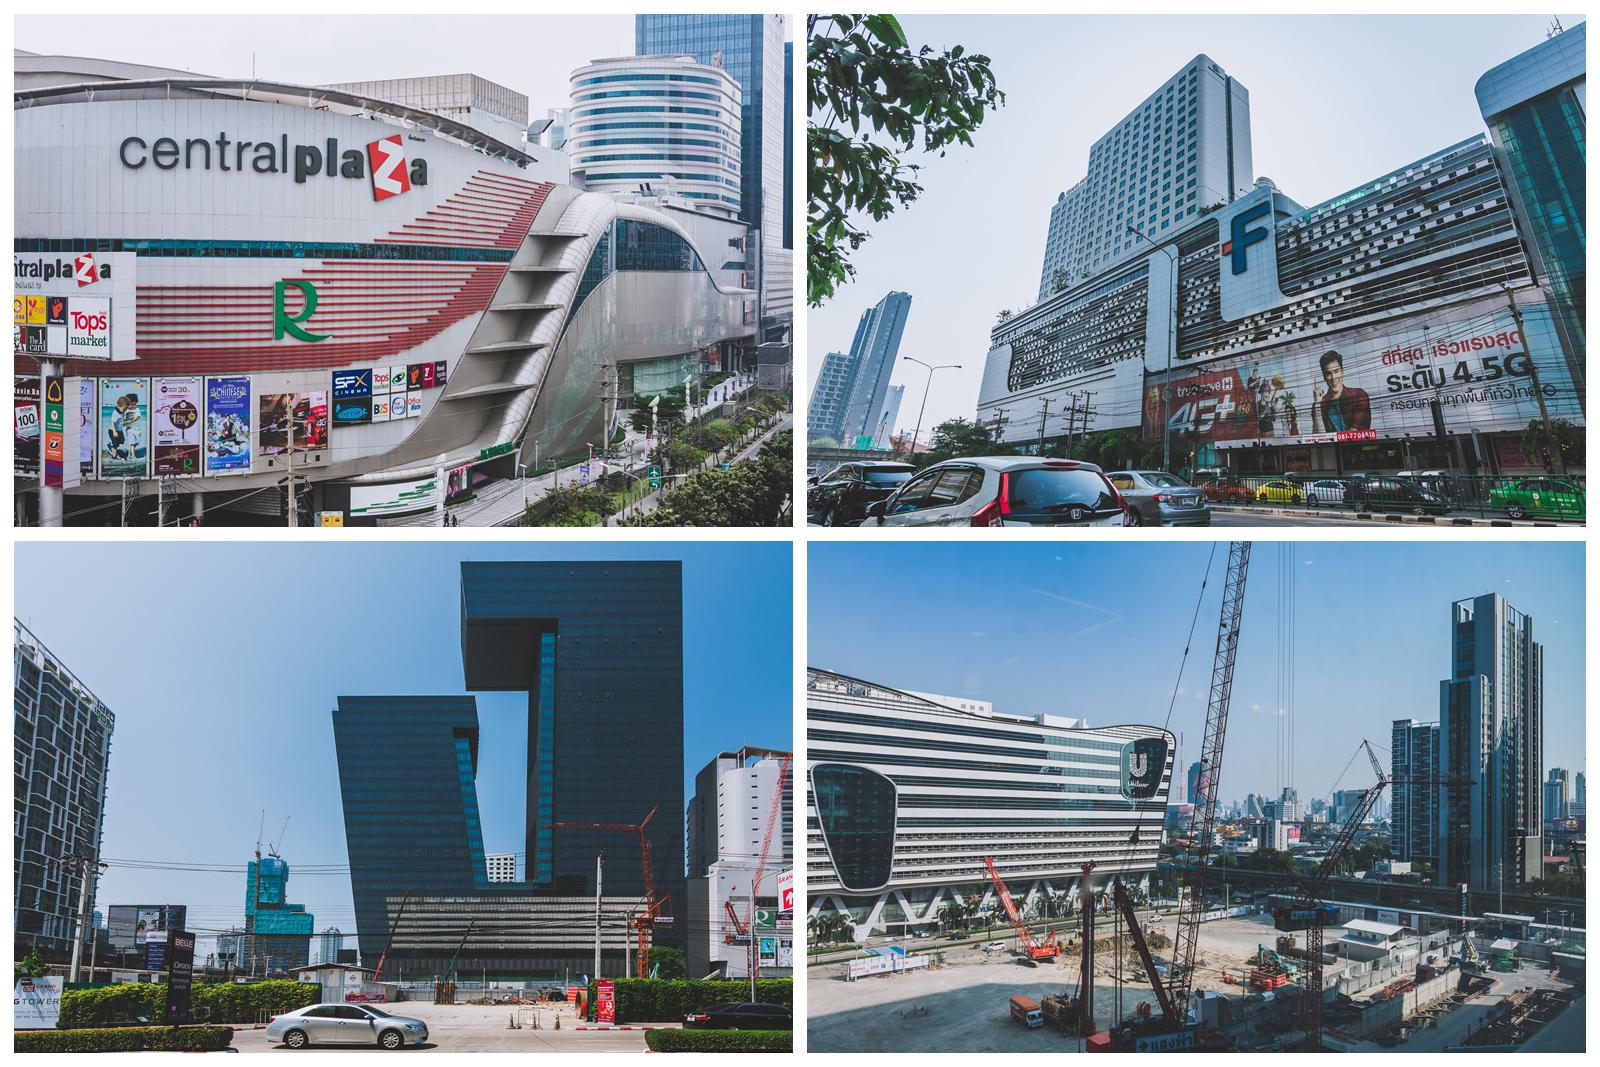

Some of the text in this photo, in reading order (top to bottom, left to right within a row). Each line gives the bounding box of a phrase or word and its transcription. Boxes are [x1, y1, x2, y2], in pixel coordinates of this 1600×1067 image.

[274, 281, 333, 342] R
[70, 311, 107, 336] Tops
[70, 335, 107, 347] market
[335, 370, 369, 389] SFX
[216, 387, 241, 398] CHINESE
[175, 938, 193, 948] BELLE
